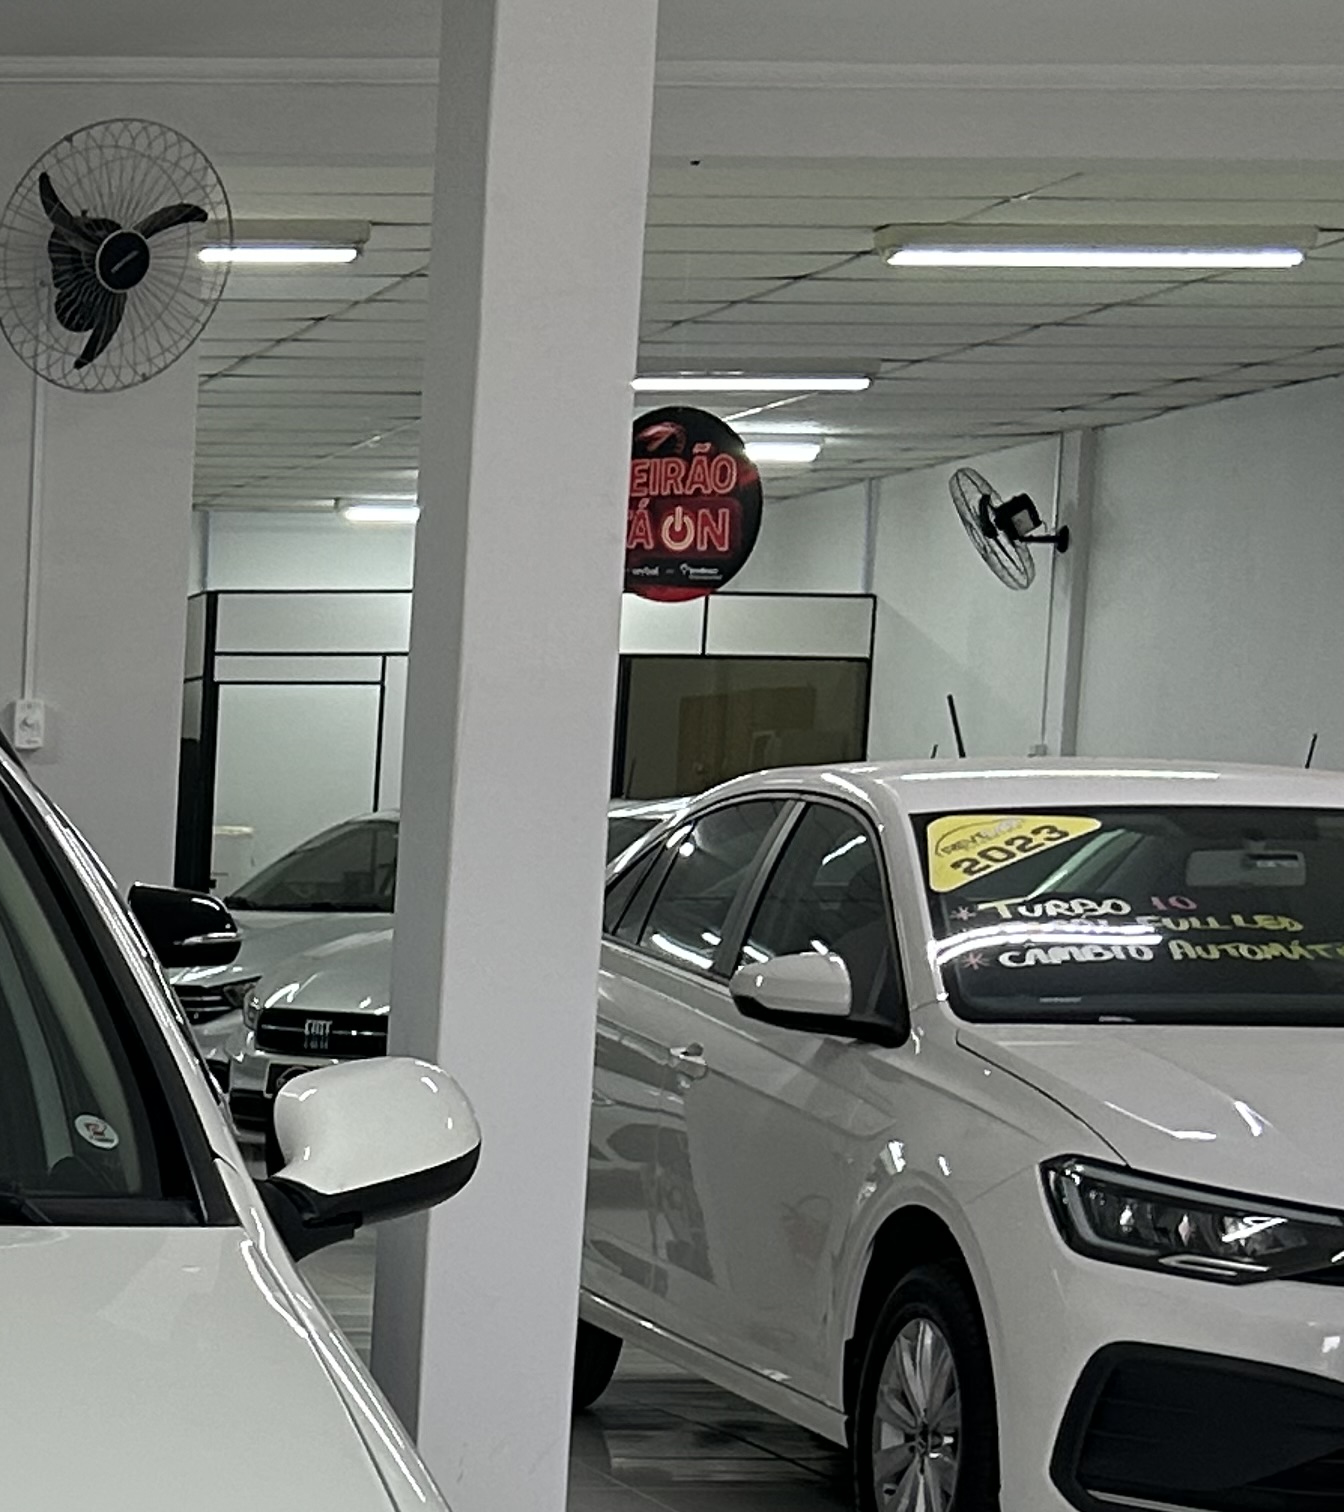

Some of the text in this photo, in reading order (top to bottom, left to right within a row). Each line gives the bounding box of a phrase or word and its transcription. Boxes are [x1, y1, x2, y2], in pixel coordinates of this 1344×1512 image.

[630, 442, 737, 497] EIRÃO
[627, 497, 654, 549] Á
[950, 825, 1069, 876] 2023
[977, 898, 1132, 919] TURBO
[1135, 914, 1232, 932] FULL
[1230, 914, 1305, 932] LED
